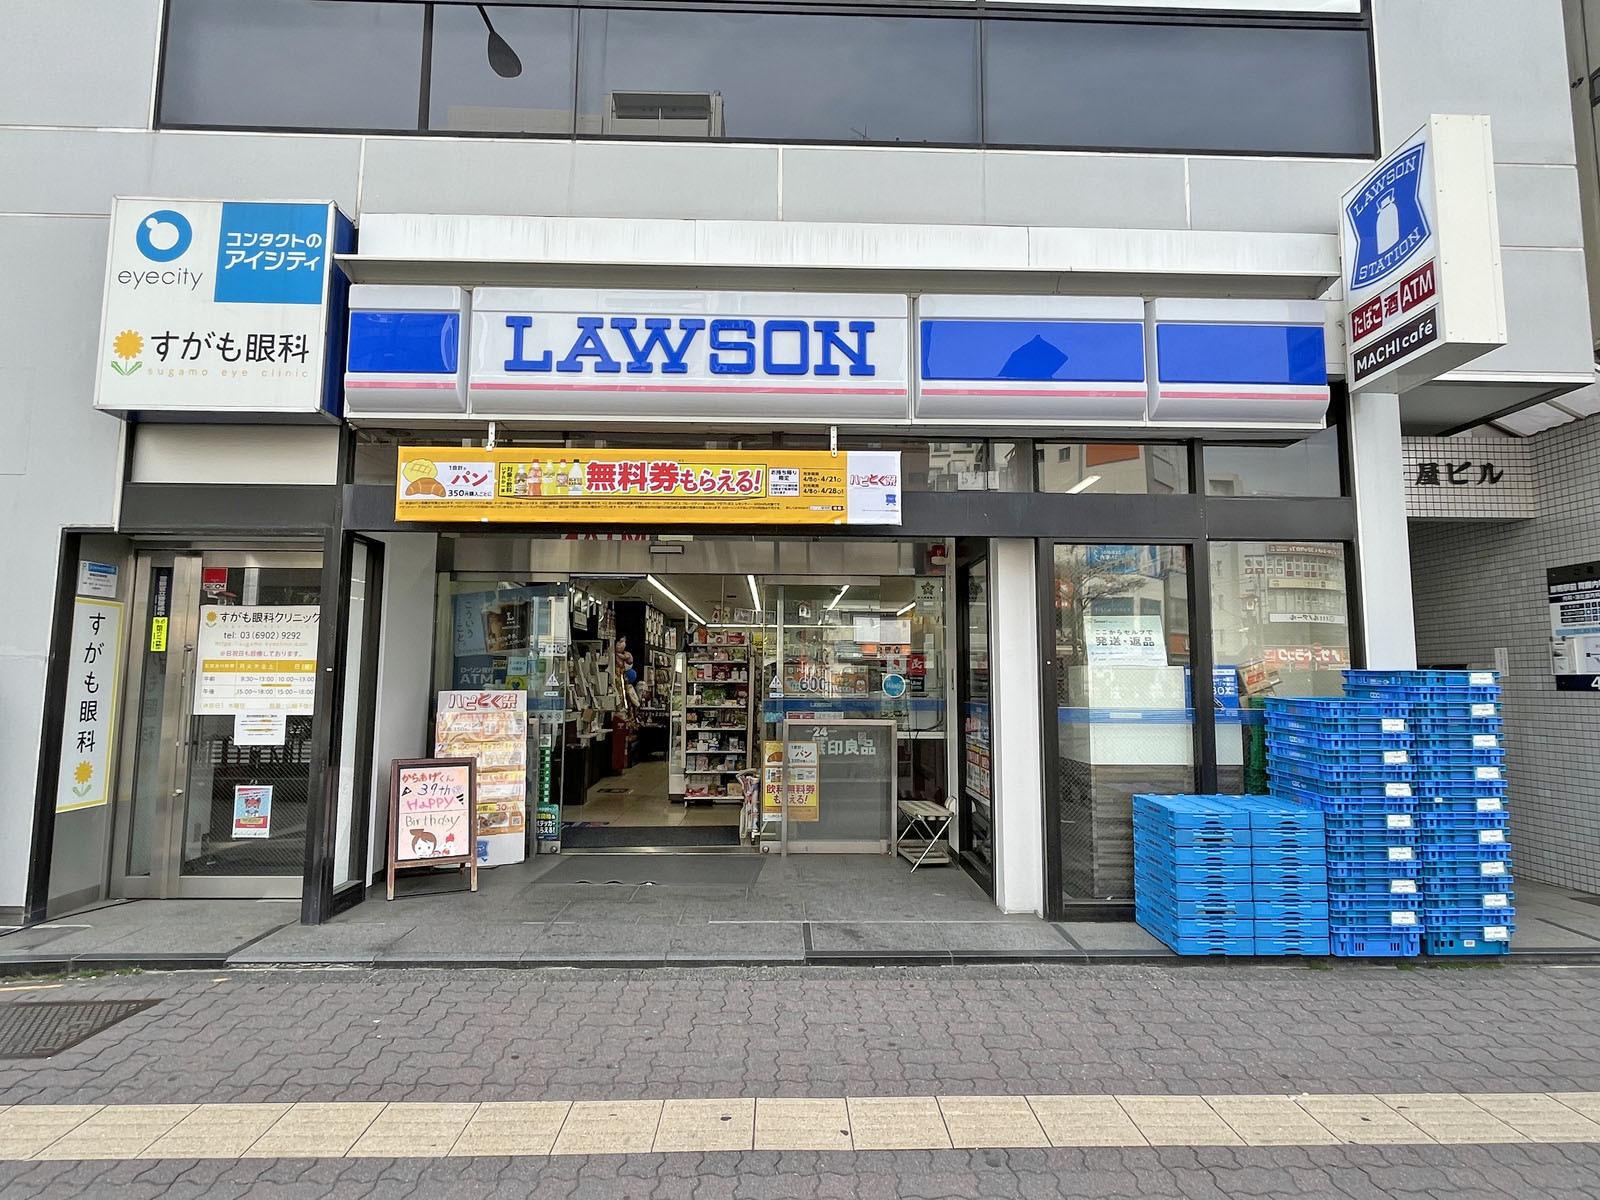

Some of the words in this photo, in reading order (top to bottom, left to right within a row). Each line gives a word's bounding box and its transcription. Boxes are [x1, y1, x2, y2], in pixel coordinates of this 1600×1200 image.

[1353, 155, 1418, 216] LAWSON
[226, 233, 323, 248] コンタクトの
[224, 250, 321, 271] アイシティ
[1359, 226, 1421, 281] STATION
[117, 268, 203, 291] eyecity
[1353, 298, 1382, 337] たばこ
[1384, 292, 1398, 318] 酒
[1401, 269, 1433, 309] ATM
[150, 331, 310, 364] すがも眼科
[504, 316, 875, 376] LAWSON
[1356, 335, 1401, 374] MACHI
[1401, 320, 1433, 349] café
[147, 367, 208, 378] sugamo
[221, 368, 249, 378] eye
[261, 368, 309, 378] clinic
[451, 470, 488, 487] パン
[586, 461, 762, 493] 無料券もらえる!
[1414, 461, 1504, 485] 屋ビル
[220, 612, 320, 625] すがも眼科クリニック
[224, 631, 238, 640] tel:
[77, 612, 106, 753] すがも眼科
[460, 674, 494, 684] ATM
[448, 692, 518, 711] ハピとく祭
[812, 726, 828, 737] 24
[402, 772, 454, 784] からあげくん
[774, 794, 808, 805] もえる!
[405, 814, 460, 832] Birthday
